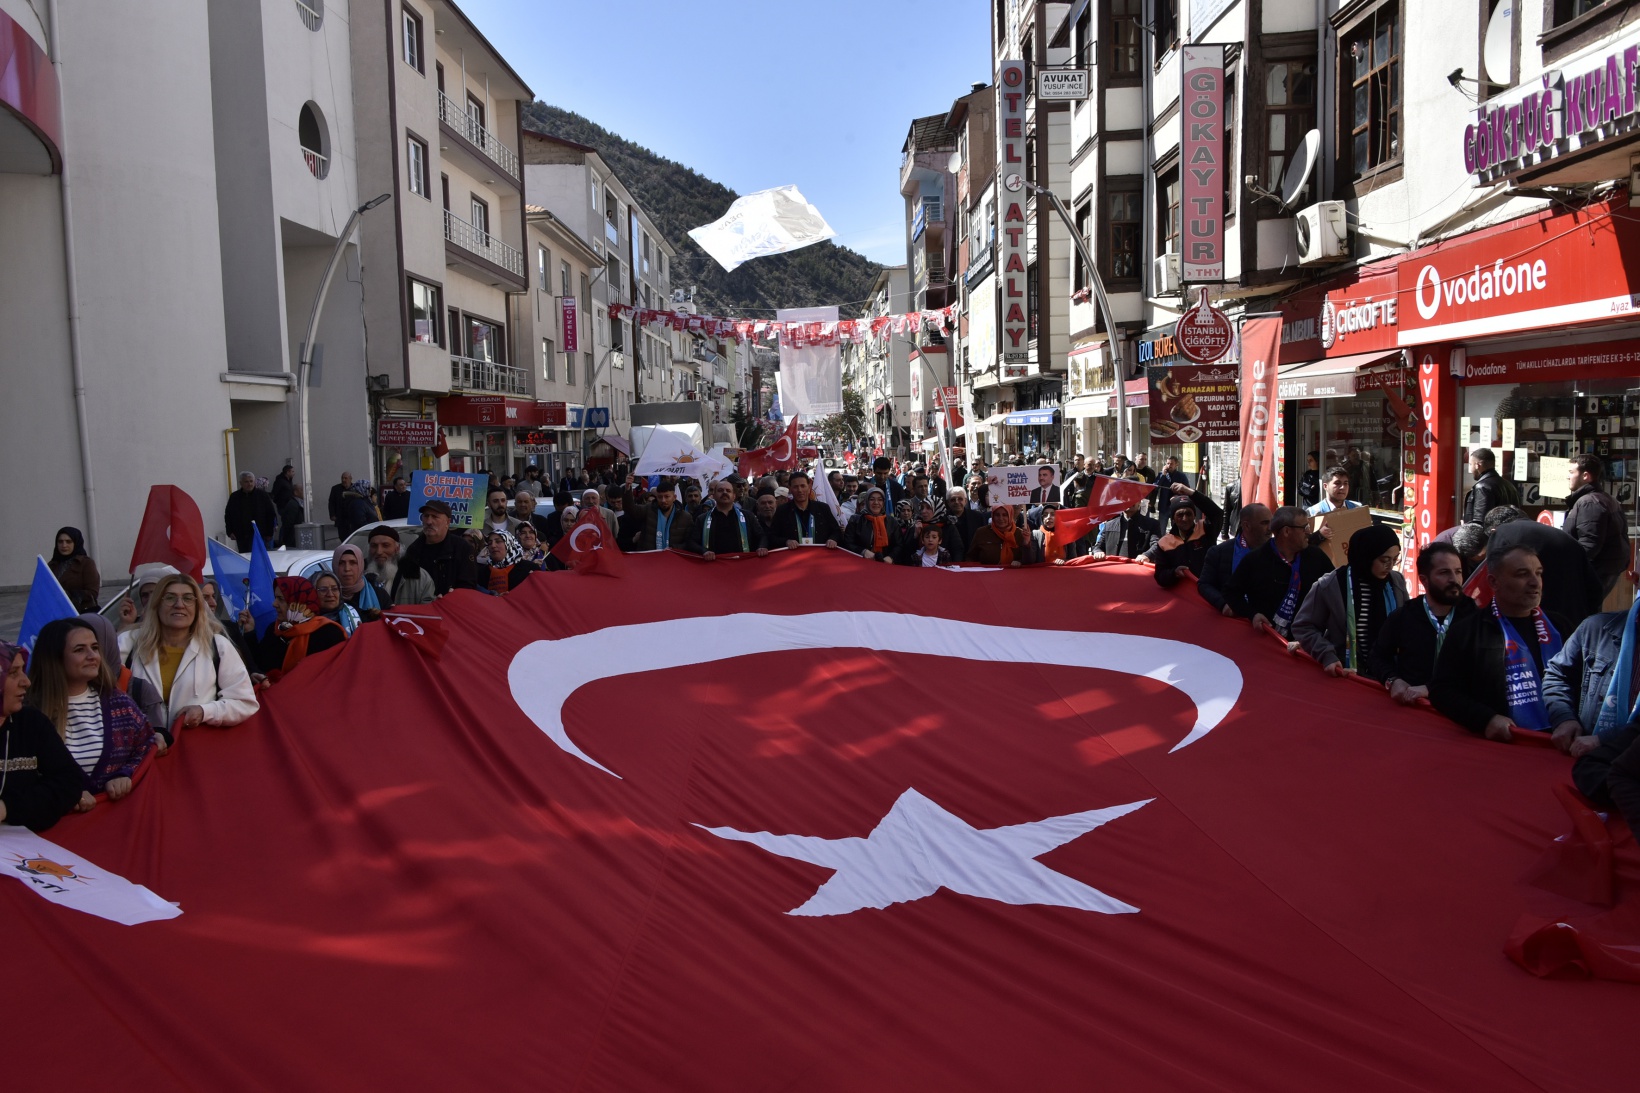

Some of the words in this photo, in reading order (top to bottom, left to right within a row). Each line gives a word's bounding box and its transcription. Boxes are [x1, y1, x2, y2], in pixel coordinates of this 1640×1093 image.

[1044, 74, 1084, 83] AVUKAT
[1003, 67, 1022, 163] OTEL
[1463, 74, 1555, 176] GÖKTUĞ
[1005, 203, 1026, 347] ATALAY
[1195, 268, 1221, 277] THY
[1442, 258, 1547, 307] vodafone
[1610, 301, 1629, 314] Ayaz
[1336, 297, 1397, 342] ÇİĞKÖFTE
[1184, 326, 1226, 335] İSTANBUL
[1185, 336, 1226, 348] ÇİĞKÖFTE
[1473, 363, 1507, 377] vodafone
[1516, 361, 1526, 370] TÜM
[1526, 360, 1543, 369] AKILLI
[1543, 357, 1576, 368] CİHAZLARDA
[1577, 353, 1610, 364] TARİFENİZE
[1610, 354, 1619, 363] EK
[1181, 385, 1216, 394] RAMAZAN
[381, 421, 433, 431] MEŞHUR
[1205, 428, 1240, 437] SİZLERLEYİ
[424, 473, 438, 486] İŞİ
[439, 475, 475, 487] EHLİNE
[1007, 477, 1028, 485] MİLLET
[423, 485, 475, 500] OYLAR
[1008, 490, 1031, 498] HİZMET
[1505, 670, 1534, 683] RCAN
[1505, 680, 1538, 693] İMEN
